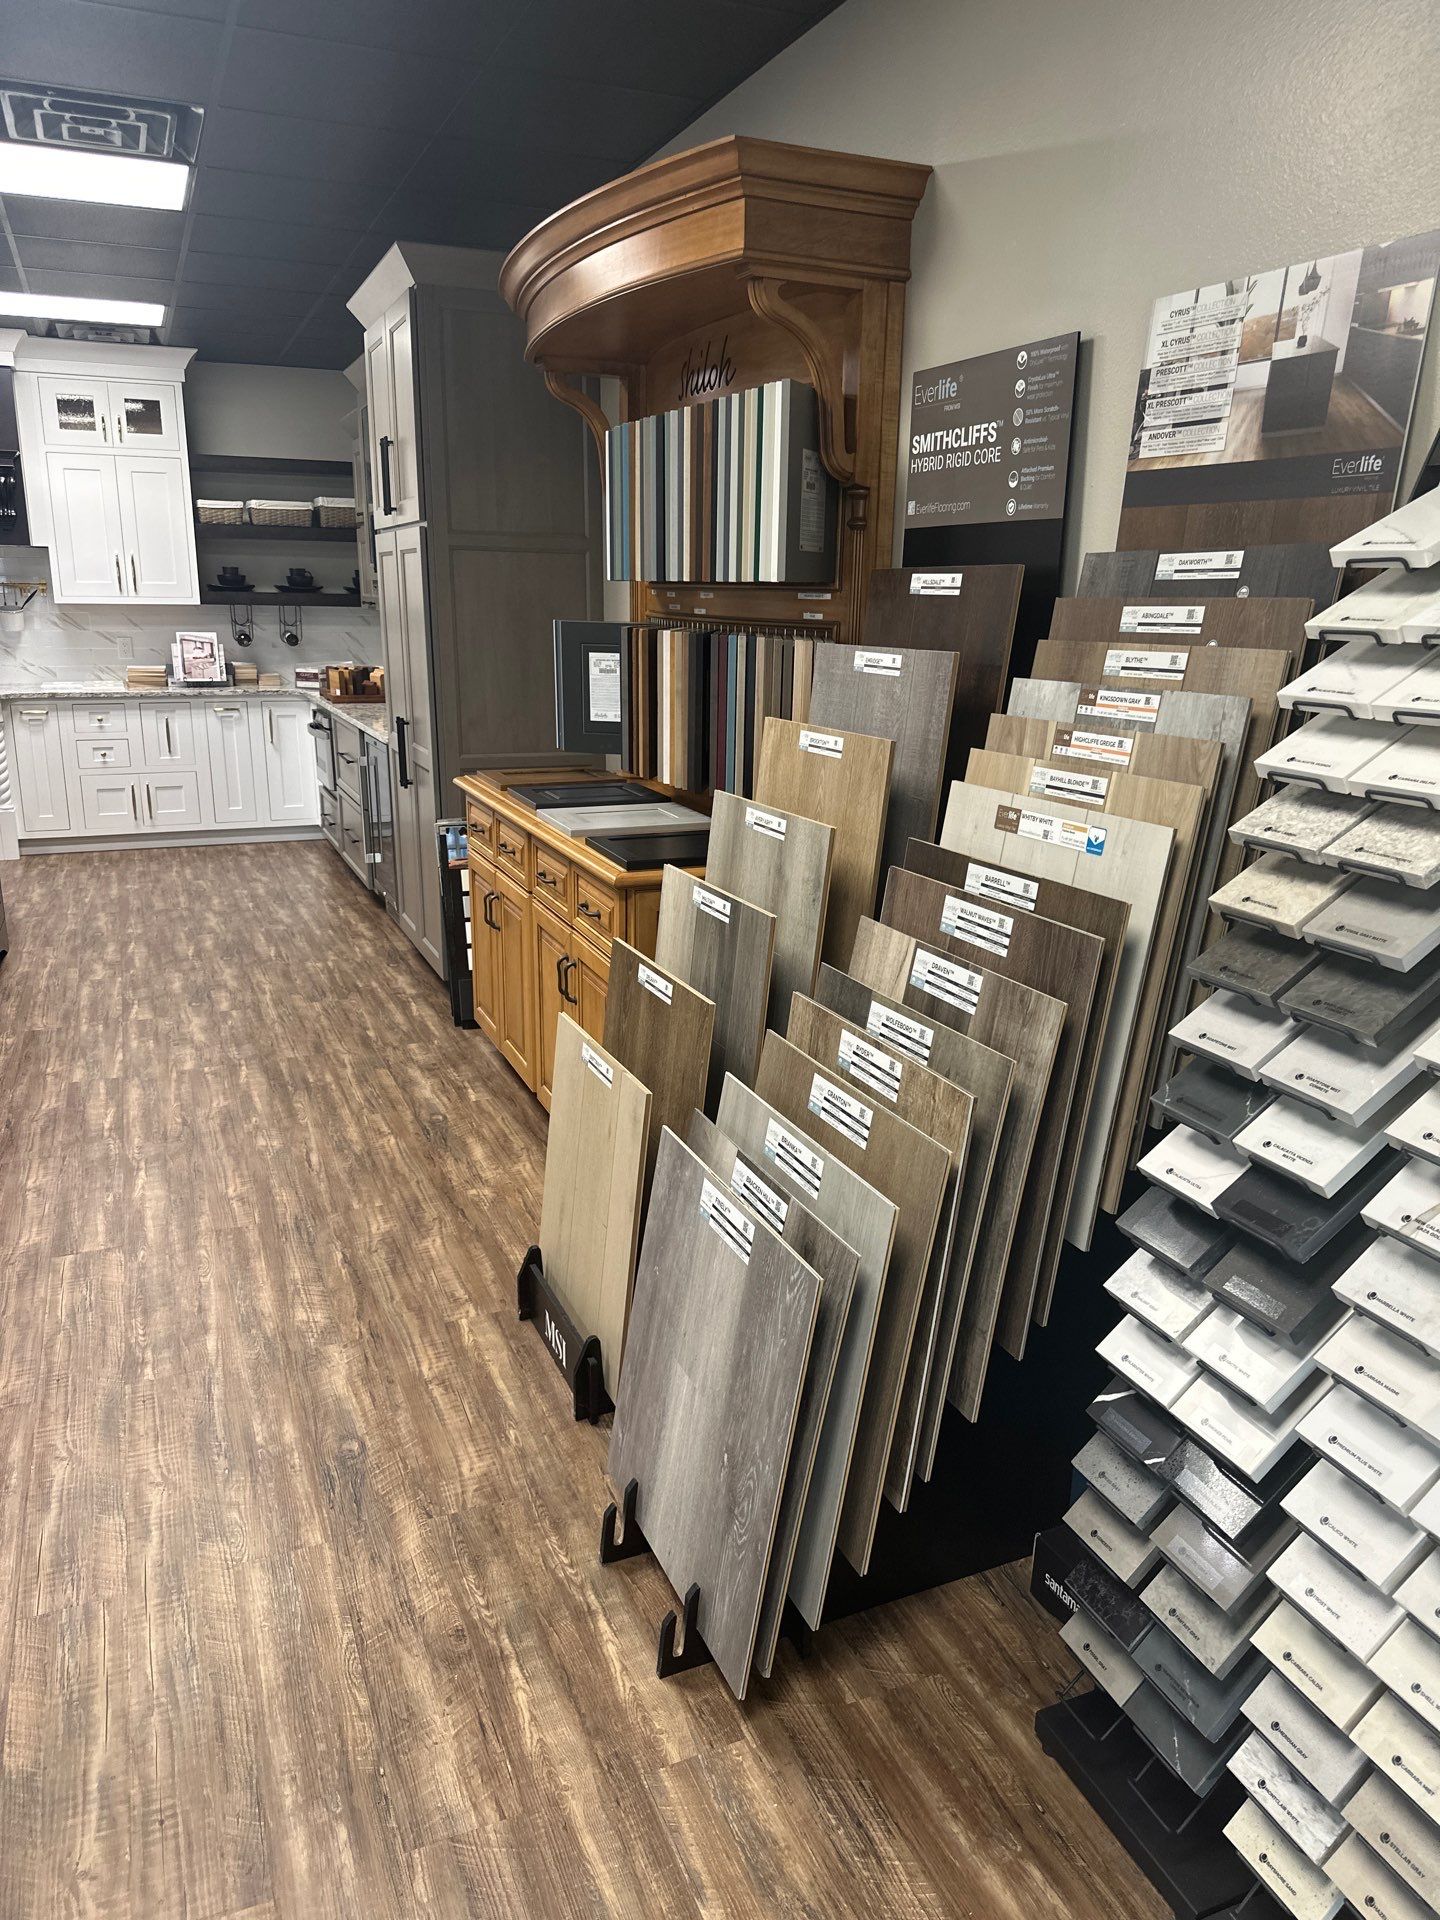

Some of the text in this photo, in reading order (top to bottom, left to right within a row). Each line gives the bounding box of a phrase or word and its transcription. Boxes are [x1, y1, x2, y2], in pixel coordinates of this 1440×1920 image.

[1161, 340, 1168, 348] XL
[678, 334, 737, 401] Shiloh
[914, 378, 958, 406] Everlife
[1146, 401, 1154, 410] XL
[911, 455, 944, 474] HYBRID
[946, 451, 972, 468] RIGID
[974, 446, 1002, 464] CORE
[1332, 454, 1382, 474] Everlife
[1100, 695, 1128, 703] KINGSDOWN
[1074, 736, 1116, 748] HIGHCLIFFE GREIGE
[1050, 775, 1066, 784] BAYHILL
[1022, 814, 1054, 826] WHITBY WHITE
[960, 908, 977, 918] WALNUT
[1376, 1298, 1416, 1322] MARBELLA WHITE
[544, 1308, 567, 1369] MSI
[1364, 1372, 1384, 1387] CARRARA
[1336, 1442, 1382, 1476] PREMIUM PLUS WHITE
[1328, 1523, 1358, 1548] CALICO WHITE
[1312, 1594, 1340, 1620] FROST WHITE
[1290, 1659, 1309, 1678] CARRARA
[1278, 1729, 1308, 1760] MERIDIAN GRAY
[1400, 1764, 1422, 1786] CARRARA
[1264, 1787, 1300, 1825] MONTCLAIR WHITE
[1390, 1842, 1426, 1879] STELLAR GRAY
[1266, 1860, 1297, 1896] BAYSHORE SAND
